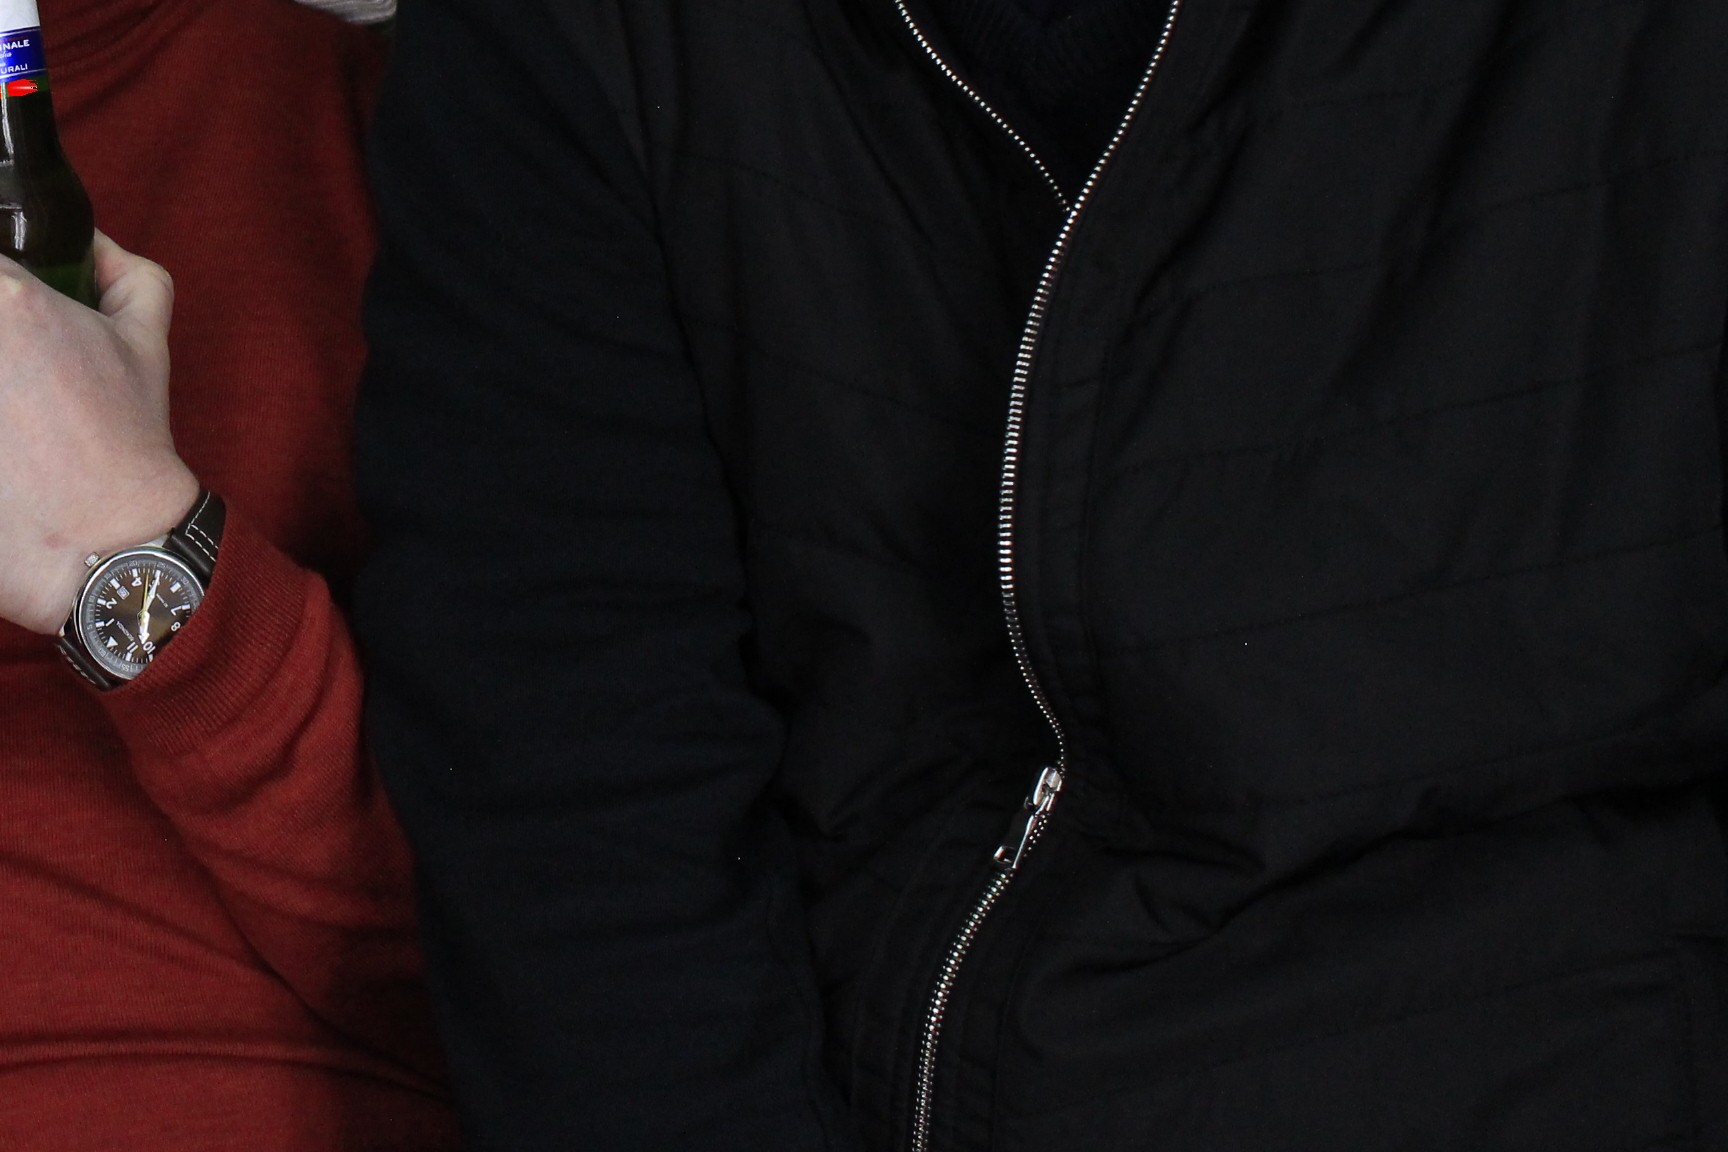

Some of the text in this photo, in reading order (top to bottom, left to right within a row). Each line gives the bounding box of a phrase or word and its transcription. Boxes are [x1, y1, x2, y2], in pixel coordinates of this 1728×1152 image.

[132, 577, 143, 587] 4
[106, 598, 117, 609] 2
[171, 621, 181, 631] 8
[126, 642, 139, 653] 11
[143, 641, 156, 654] 10
